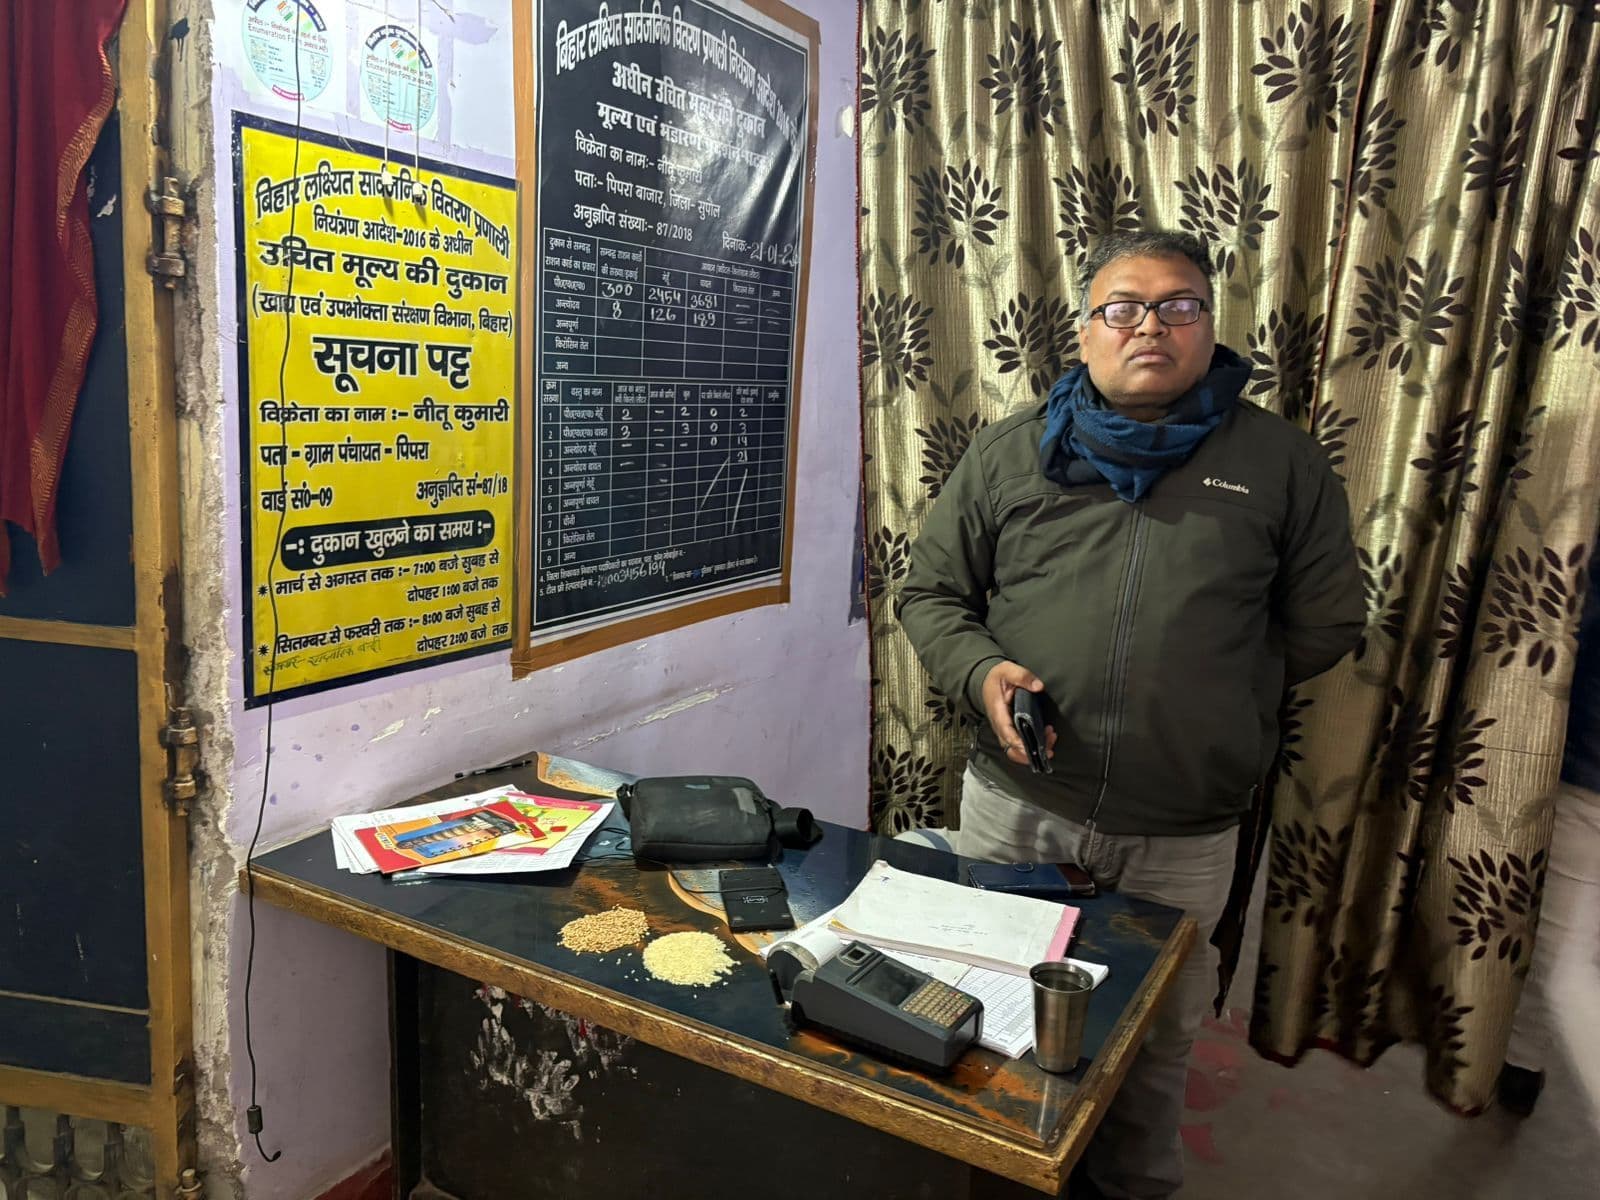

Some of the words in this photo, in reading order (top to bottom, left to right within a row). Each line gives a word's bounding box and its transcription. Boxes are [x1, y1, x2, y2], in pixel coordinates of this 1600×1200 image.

[556, 19, 588, 76] बिहार
[588, 1, 623, 58] लक्ष्यित
[624, 0, 671, 46] सार्वजनिक
[673, 5, 701, 57] वितरण
[702, 28, 728, 71] प्रणाली
[729, 35, 757, 95] नियंत्रण
[612, 61, 653, 100] अधीन
[655, 75, 687, 112] उचित
[736, 108, 767, 147] दुकान
[596, 101, 634, 131] मूल्य
[635, 114, 659, 137] एवं
[660, 120, 704, 151] भंडारण
[575, 128, 608, 159] विक्रेता
[609, 145, 624, 164] का
[256, 177, 300, 218] बिहार
[304, 162, 354, 201] लक्ष्यित
[431, 179, 471, 228] वितरण
[474, 211, 510, 259] प्रणाली
[606, 171, 634, 198] पिपरा
[698, 199, 720, 219] सुपौल
[314, 205, 359, 238] नियंत्रण
[363, 218, 426, 249] आदेश-2016
[429, 227, 440, 250] के
[443, 232, 473, 256] अधीन
[573, 202, 617, 229] अनुज्ञप्ति
[656, 221, 693, 241] 87/2018
[259, 236, 335, 272] उचित
[342, 254, 399, 288] मूल्य
[405, 257, 440, 285] की
[446, 268, 508, 298] दुकान
[601, 282, 633, 298] 300
[690, 295, 718, 309] 3681
[300, 291, 323, 316] एवं
[326, 295, 387, 321] उपभोक्ता
[392, 300, 430, 325] संरक्षण
[434, 304, 475, 331] विभाग,
[479, 308, 513, 338] बिहार)
[650, 307, 676, 321] 126
[312, 337, 418, 392] सूचना
[426, 344, 472, 389] पट्ट
[260, 400, 320, 425] विक्रेता
[324, 406, 349, 423] का
[354, 406, 386, 423] नाम
[414, 397, 453, 430] नीतू
[454, 398, 510, 430] कुमारी
[621, 408, 632, 420] 2
[680, 407, 690, 416] 2
[681, 423, 689, 434] 3
[739, 408, 748, 417] 2
[260, 445, 288, 466] पता
[304, 444, 335, 469] ग्राम
[338, 436, 381, 462] पंचायत
[396, 434, 429, 460] पिपरा
[416, 472, 464, 509] अनुज्ञप्ति
[1212, 478, 1249, 494] Columbia
[310, 530, 361, 566] दुकान
[364, 519, 410, 557] खुलने
[414, 522, 435, 543] का
[439, 519, 474, 538] समय
[276, 571, 305, 596] मार्च
[308, 572, 321, 591] से
[324, 567, 367, 589] अगस्त
[371, 565, 394, 581] तक
[413, 561, 436, 575] 7:00
[439, 553, 459, 571] बजे
[461, 553, 486, 574] सुबह
[488, 549, 500, 565] से
[407, 584, 439, 603] दोपहर
[442, 583, 461, 598] 1:00
[462, 577, 480, 593] बजे
[481, 575, 499, 590] तक
[276, 633, 326, 656] सितम्बर
[330, 627, 341, 643] से
[384, 618, 405, 634] तक
[422, 613, 443, 626] 8:00
[445, 605, 464, 621] बजे
[466, 603, 489, 624] सुबह
[491, 598, 501, 614] से
[417, 634, 449, 654] दोपहर
[450, 632, 469, 645] 2:00
[470, 624, 488, 642] बजे
[492, 622, 509, 636] तक
